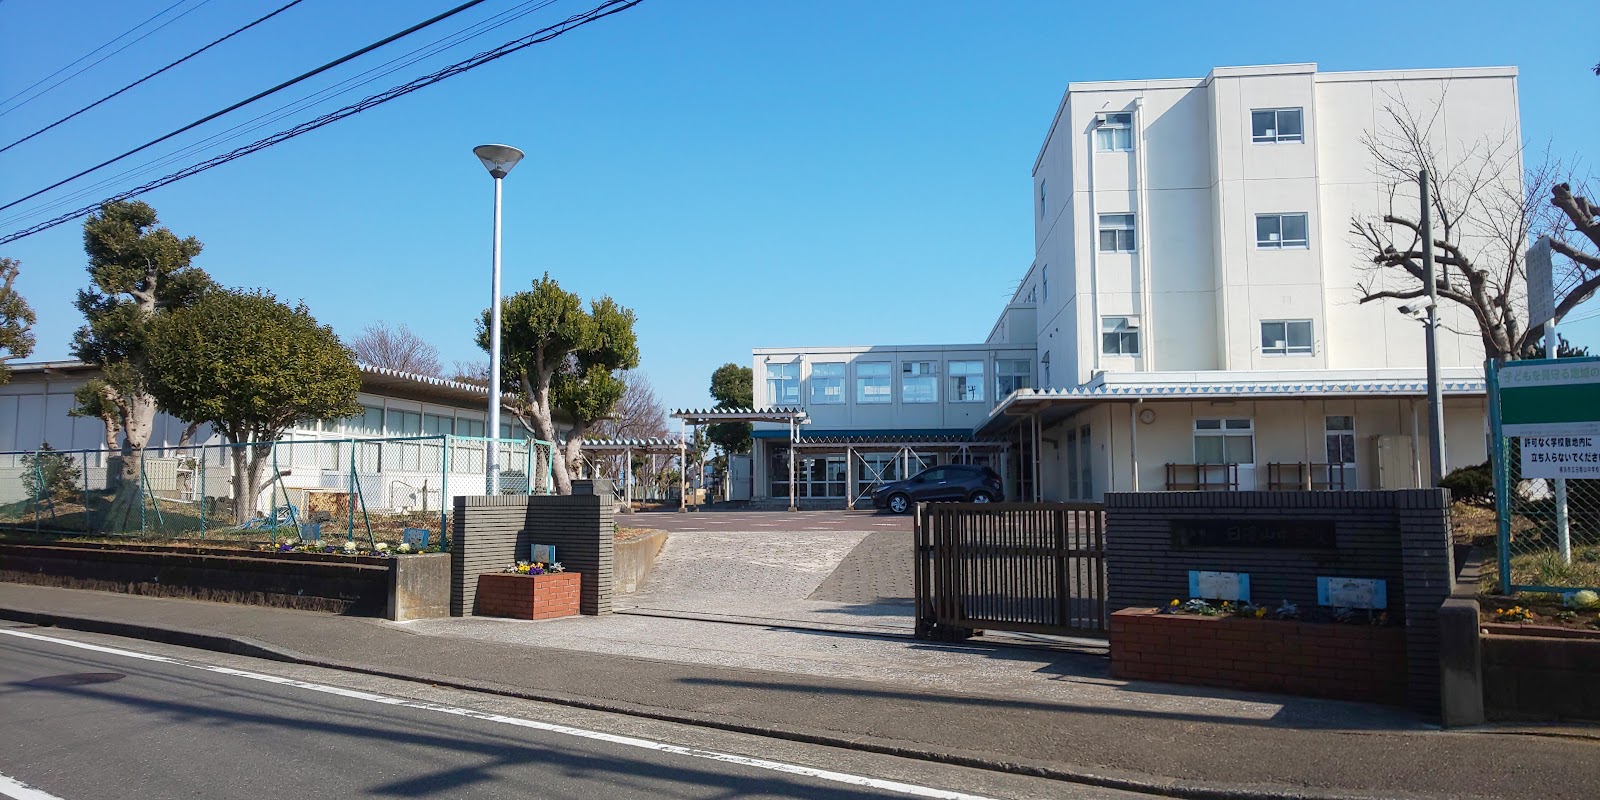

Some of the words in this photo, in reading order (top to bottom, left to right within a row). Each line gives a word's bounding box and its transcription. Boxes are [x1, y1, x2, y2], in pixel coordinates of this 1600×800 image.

[1524, 437, 1592, 448] 許可なく学校敷地内に
